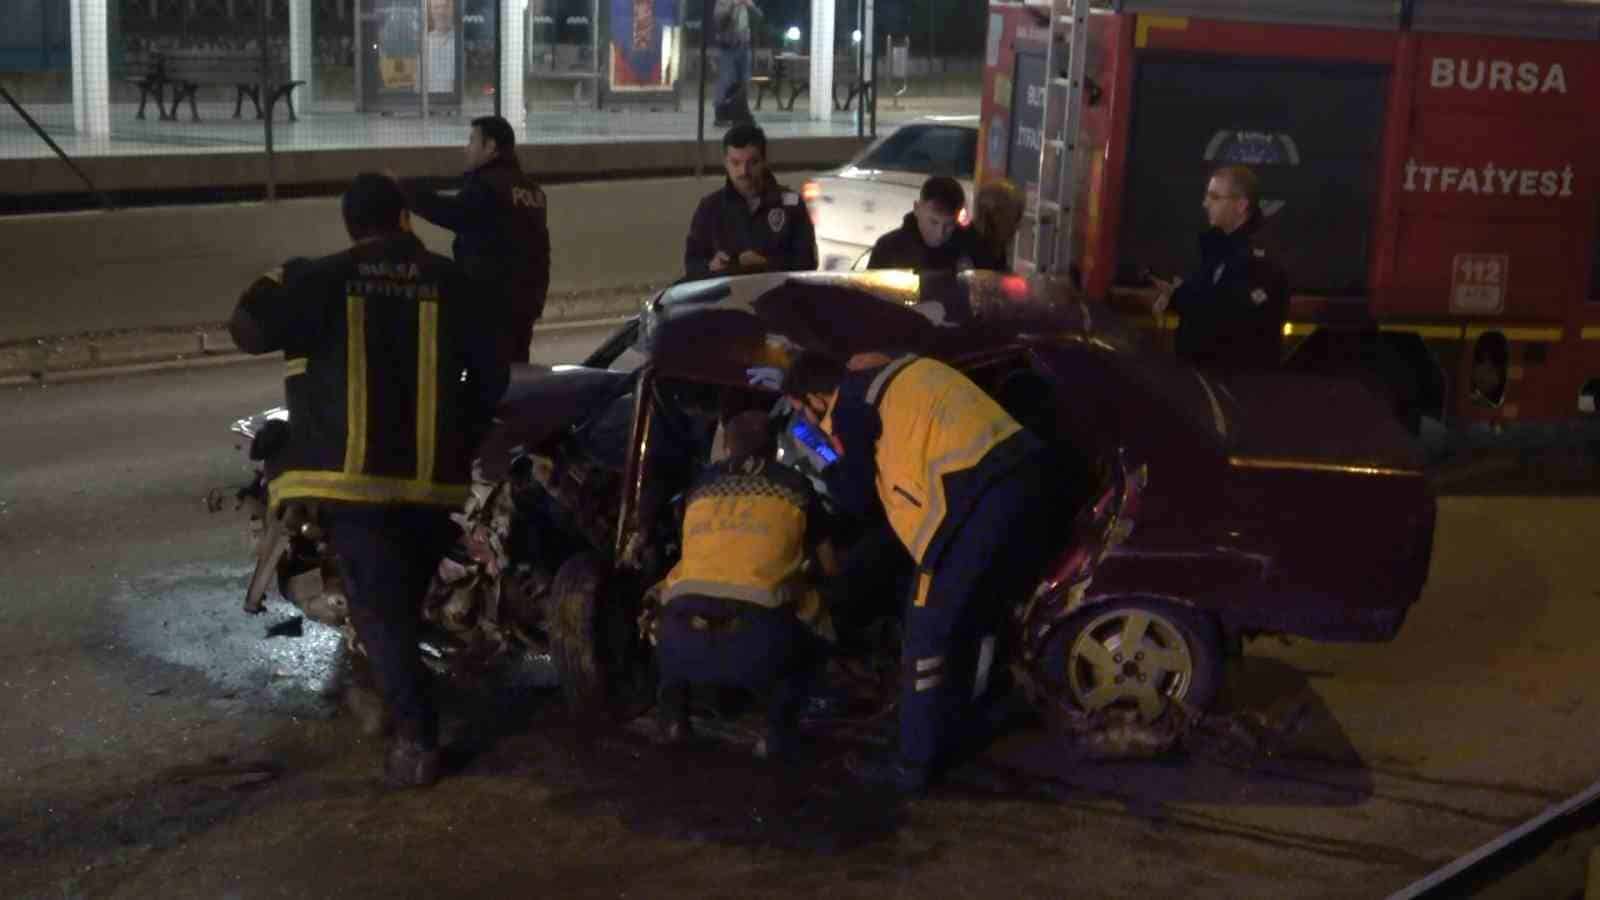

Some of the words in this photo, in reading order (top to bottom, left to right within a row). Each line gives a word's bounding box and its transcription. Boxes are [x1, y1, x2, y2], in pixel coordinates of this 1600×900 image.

[1429, 56, 1567, 94] BURSA
[1402, 158, 1576, 197] İTFAİYESİ
[1461, 259, 1501, 283] 112
